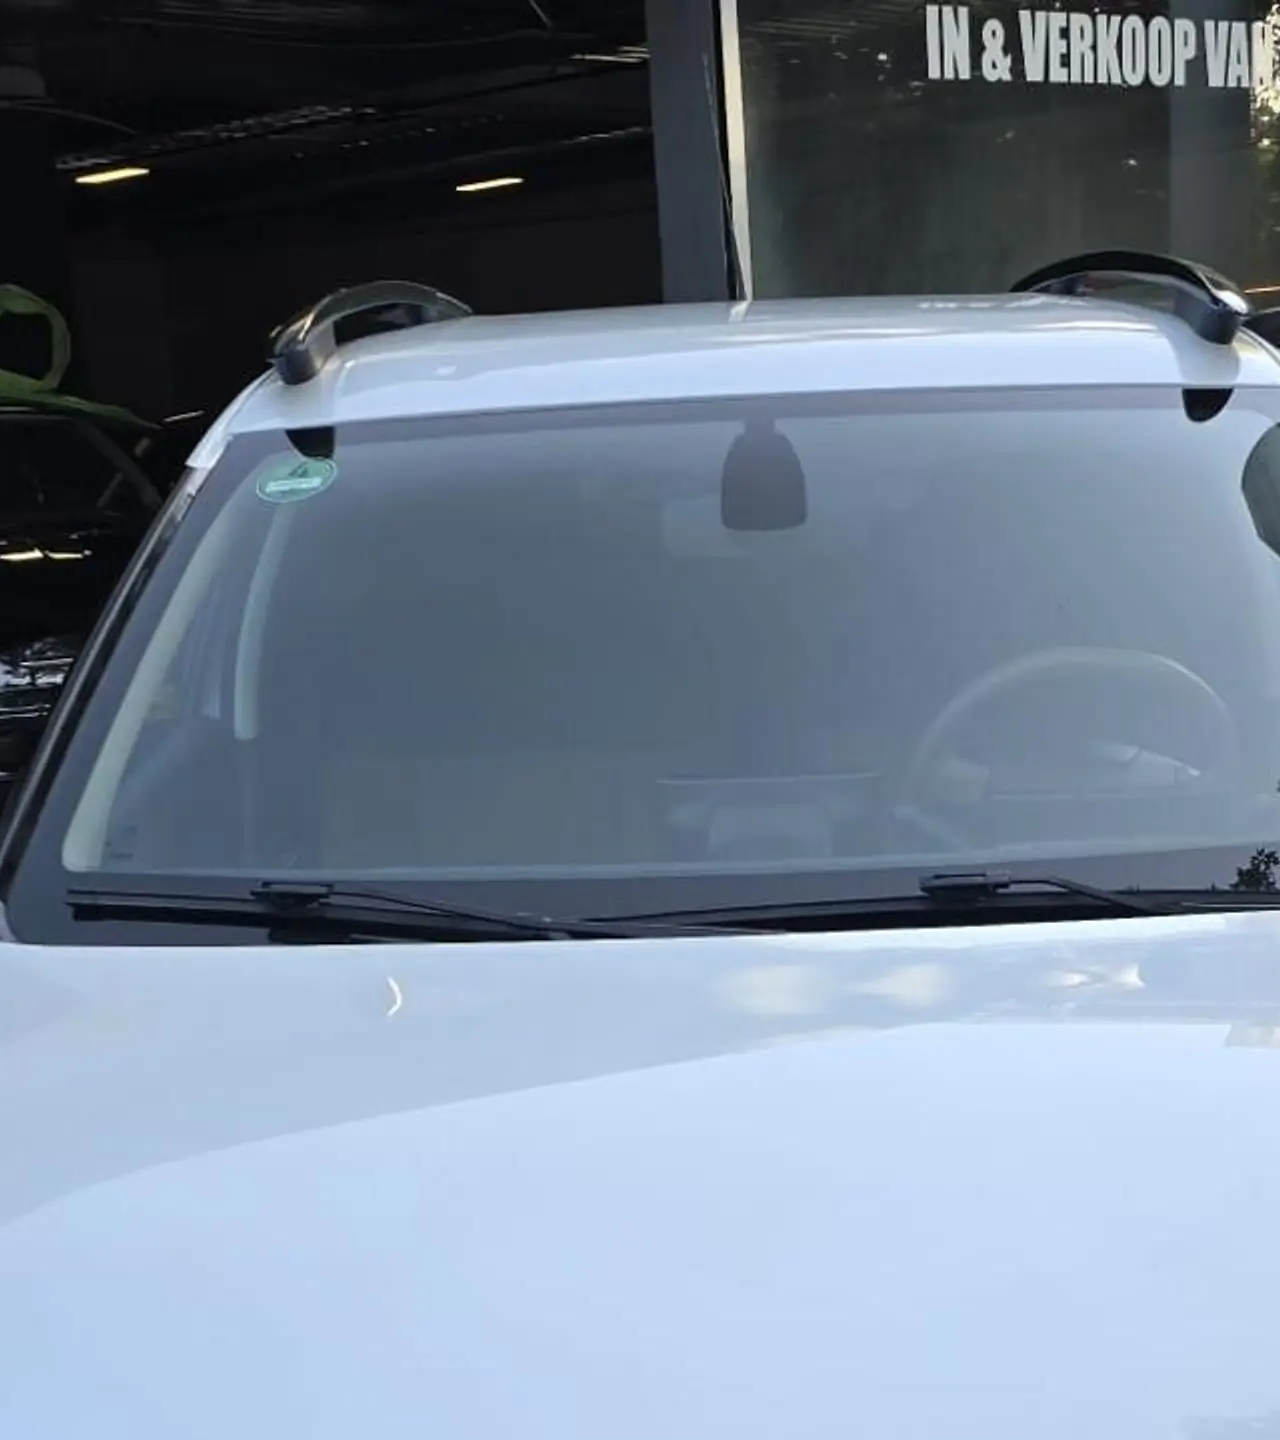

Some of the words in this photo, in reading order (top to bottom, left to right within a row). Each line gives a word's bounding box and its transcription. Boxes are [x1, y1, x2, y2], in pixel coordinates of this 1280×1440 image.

[926, 5, 970, 80] IN
[982, 18, 1012, 82] &
[1019, 10, 1196, 87] VERKOOP
[1204, 19, 1273, 90] VAN
